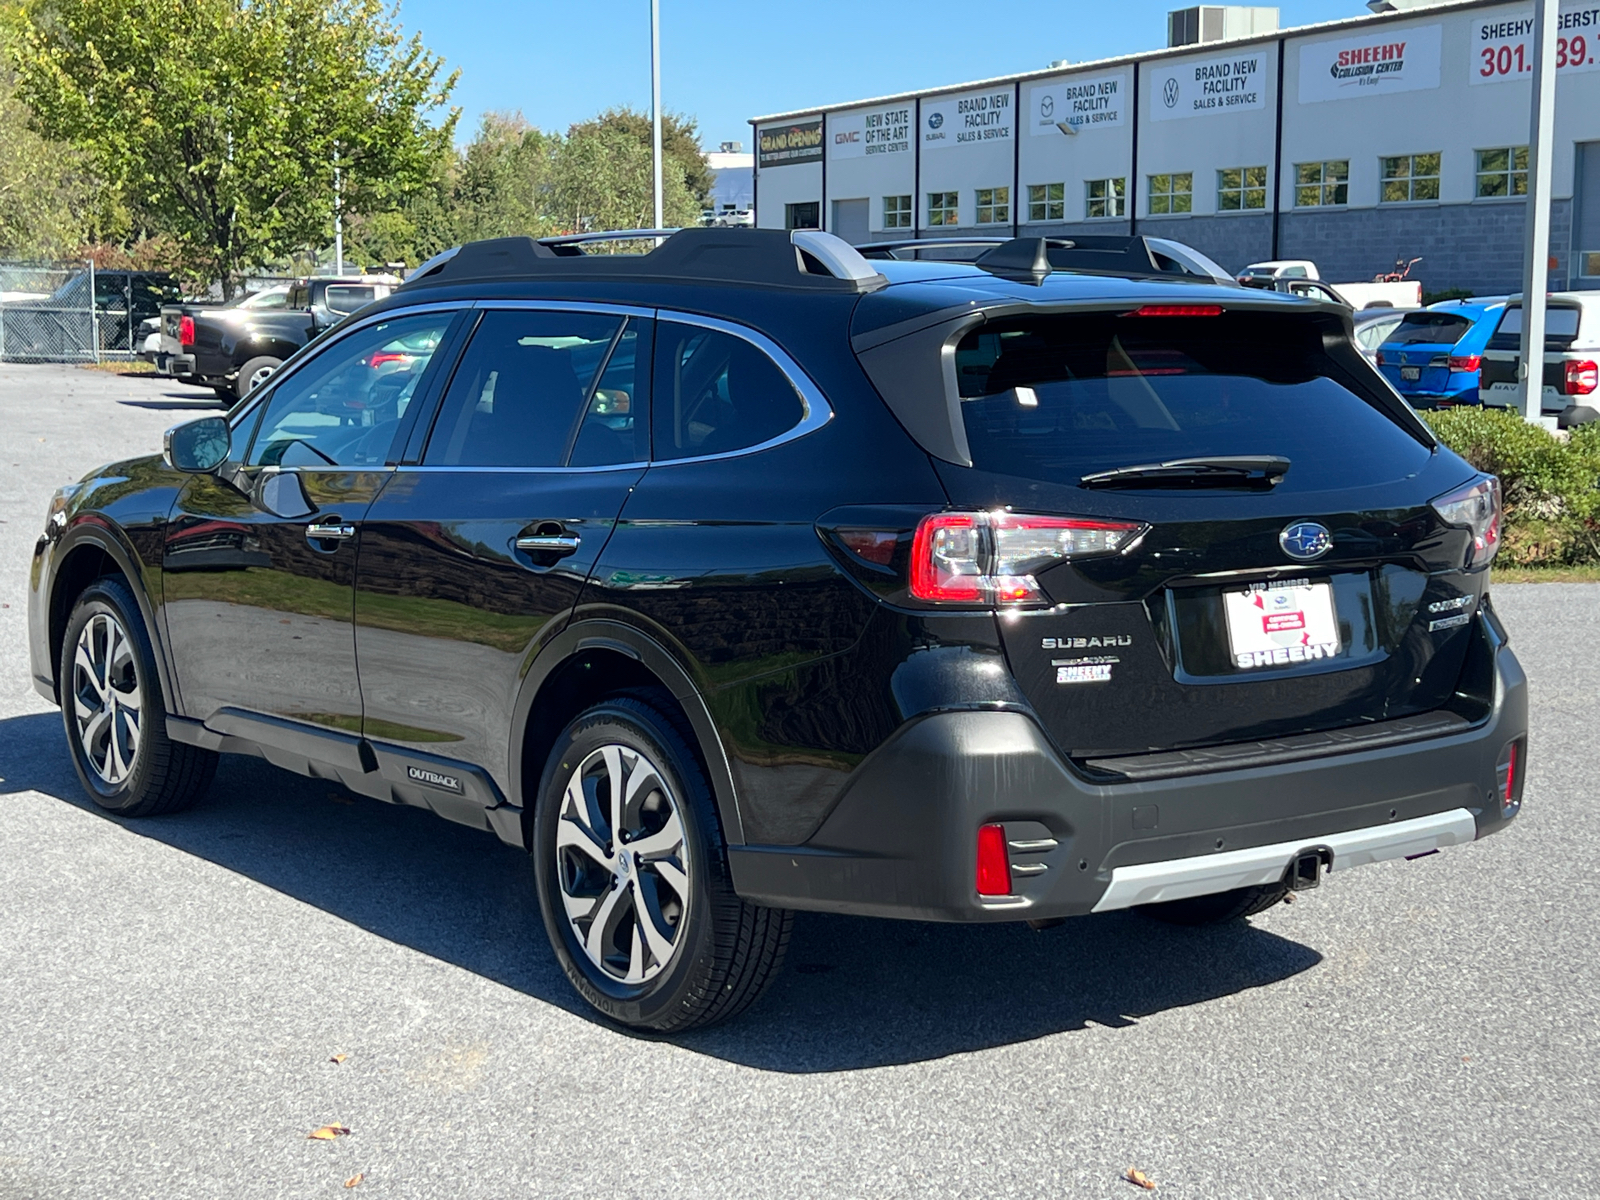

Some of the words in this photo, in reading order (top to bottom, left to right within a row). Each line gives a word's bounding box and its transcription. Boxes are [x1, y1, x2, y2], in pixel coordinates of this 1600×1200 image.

[1481, 18, 1534, 40] SHEEHY
[1338, 42, 1407, 67] SHEEHY
[1195, 63, 1231, 81] BRAND
[1233, 59, 1258, 75] NEW
[1338, 64, 1375, 79] COLLISION
[1375, 60, 1404, 75] CENTER
[1066, 84, 1096, 100] BRAND
[1098, 81, 1118, 96] NEW
[1203, 76, 1248, 95] FACILITY
[958, 97, 988, 114] BRAND
[989, 94, 1010, 109] NEW
[1073, 96, 1109, 113] FACILITY
[1193, 97, 1216, 110] SALES
[1217, 96, 1224, 107] &
[1225, 92, 1257, 106] SERVICE
[866, 113, 884, 128] NEW
[885, 110, 909, 126] STATE
[965, 110, 1002, 128] FACILITY
[1065, 116, 1084, 125] SALES
[1085, 114, 1090, 124] &
[1091, 111, 1118, 123] SERVICE
[761, 134, 787, 151] GRAND
[788, 129, 822, 147] OPENING
[835, 131, 860, 145] GMC
[866, 129, 876, 143] OF
[876, 127, 891, 142] THE
[892, 126, 909, 140] ART
[957, 131, 976, 143] SALES
[977, 130, 982, 140] &
[984, 127, 1010, 140] SERVICE
[865, 143, 887, 155] SERVICE
[888, 141, 909, 153] CENTER
[1041, 634, 1132, 649] SUBARU
[1237, 642, 1339, 668] SHEEHY
[1057, 665, 1112, 677] SHEEHY
[409, 767, 459, 789] OUTBACK
